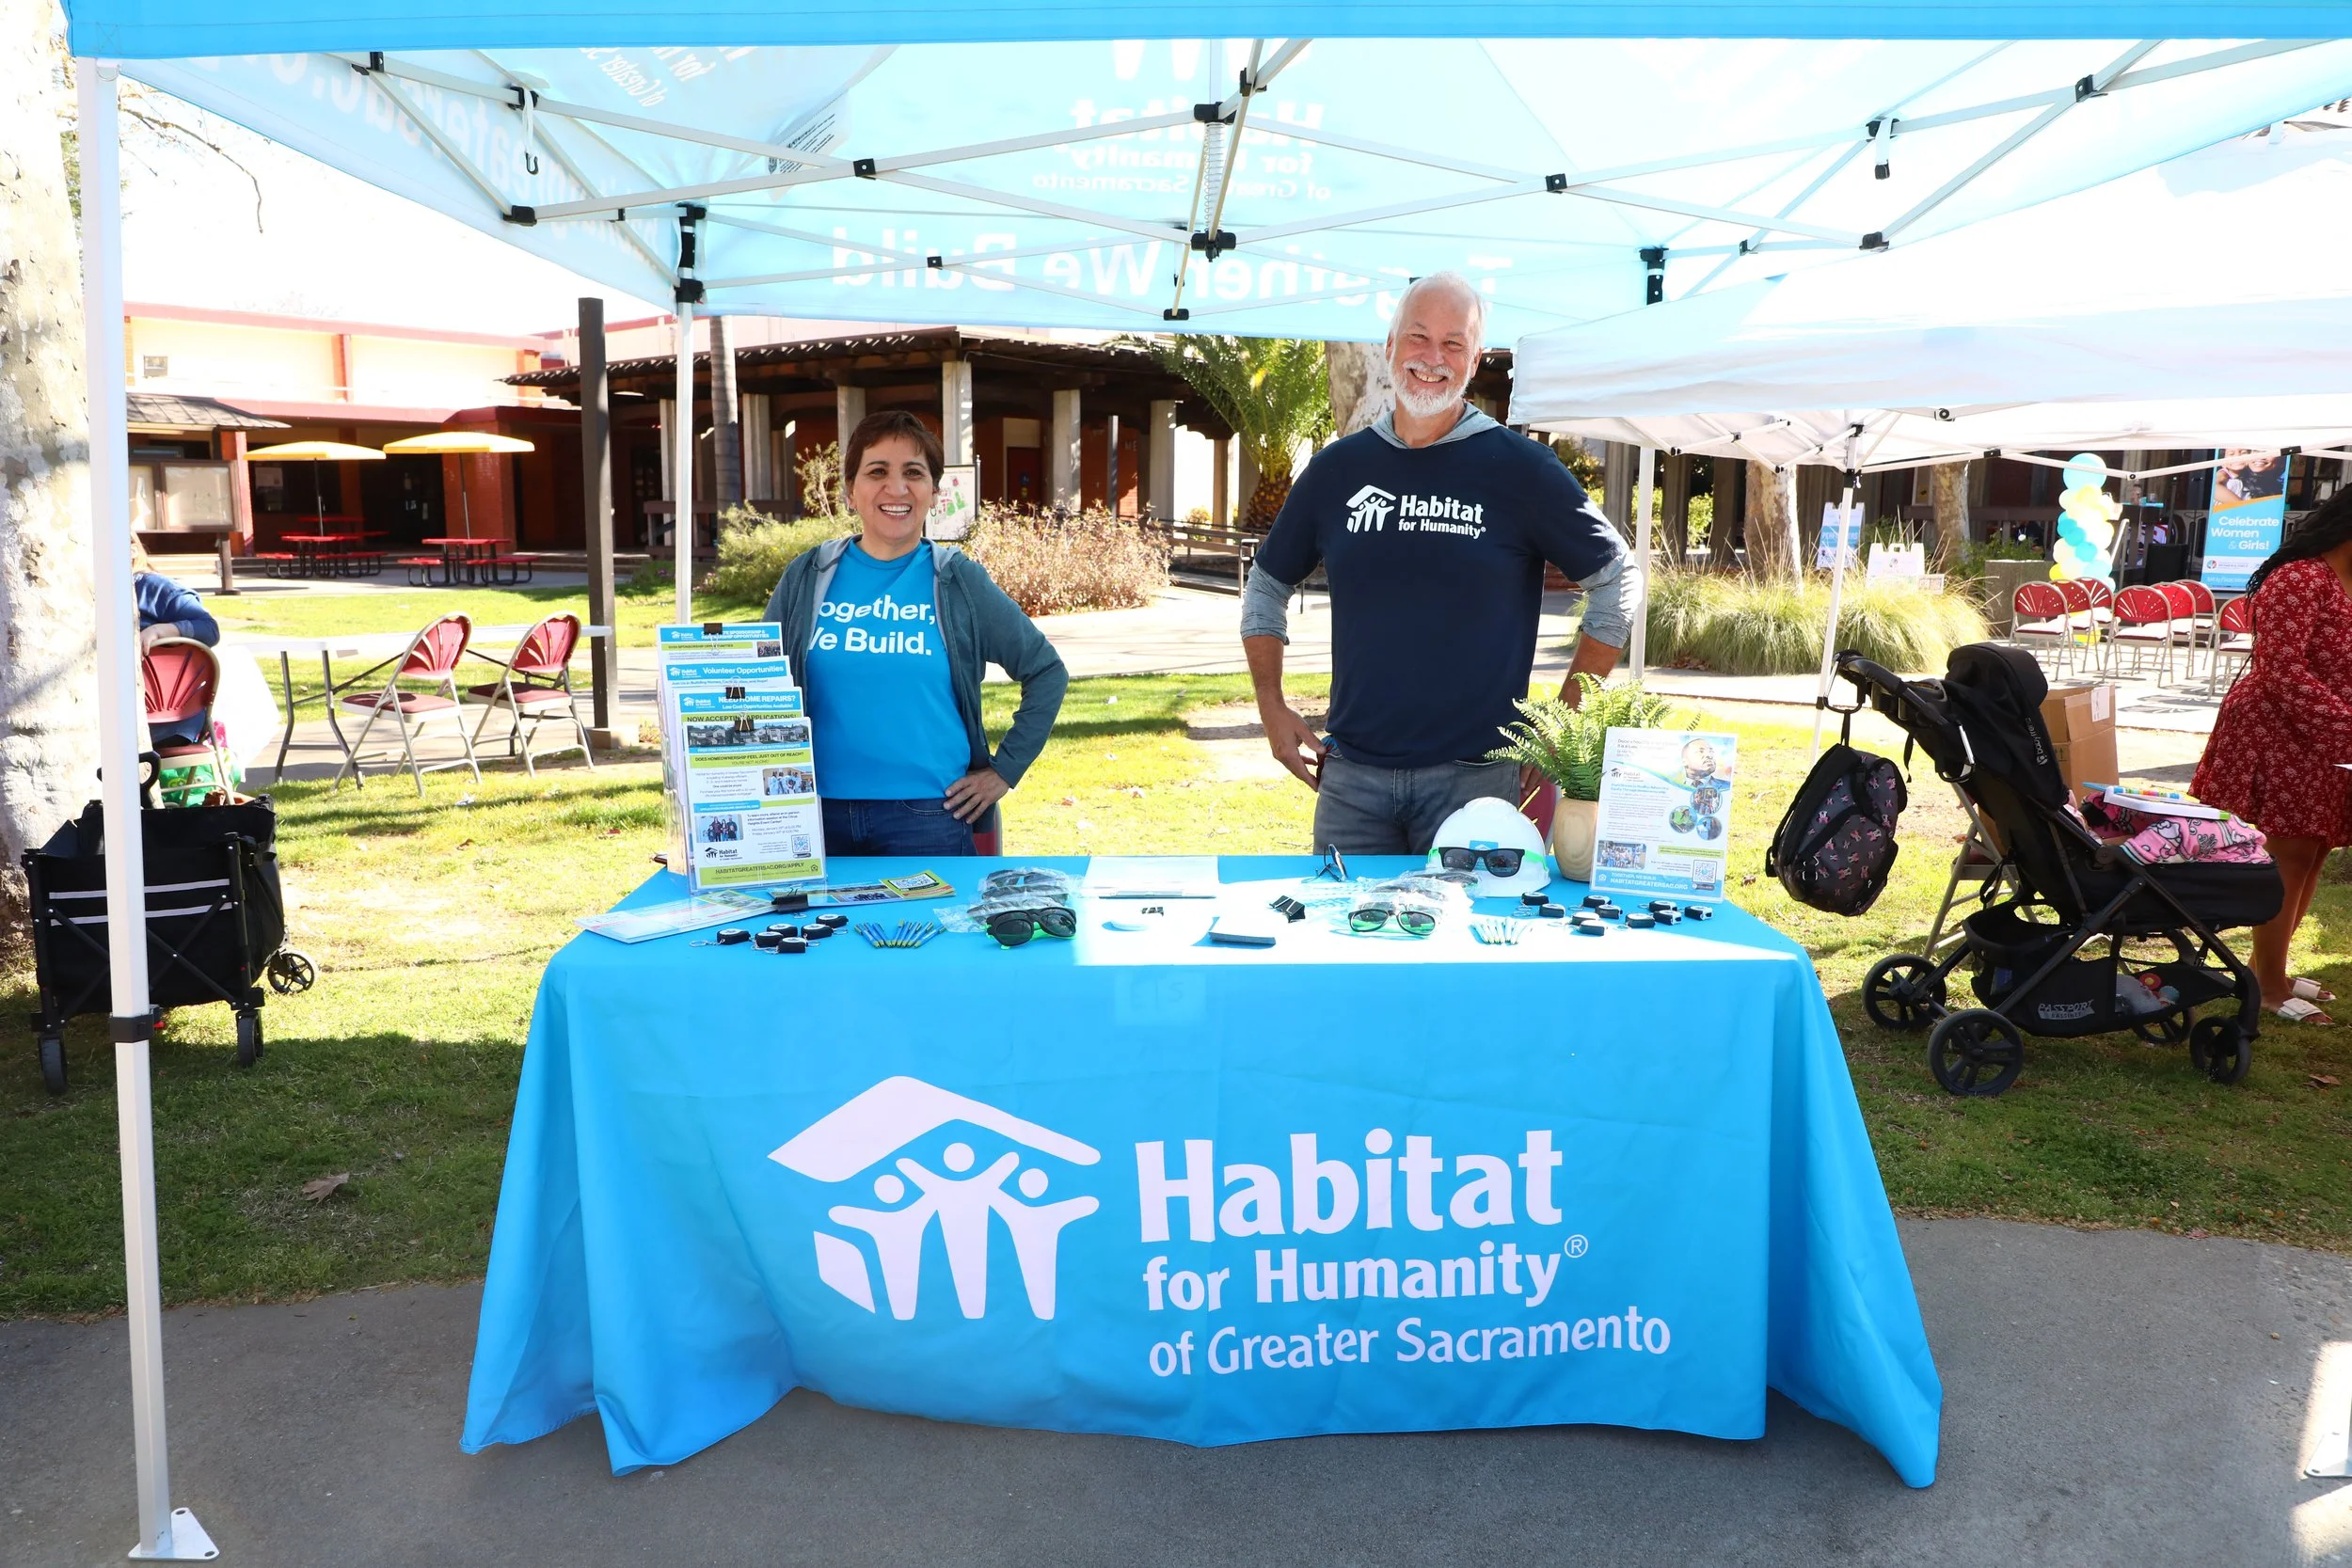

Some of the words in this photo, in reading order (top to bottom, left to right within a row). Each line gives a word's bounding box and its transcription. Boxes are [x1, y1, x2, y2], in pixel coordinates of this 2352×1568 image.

[1399, 495, 1483, 524] Habitat
[1398, 519, 1416, 531] for
[2218, 516, 2280, 526] Celebrate
[2211, 528, 2259, 538] Women
[2239, 540, 2270, 550] Girls!
[819, 594, 936, 625] ogether,
[844, 627, 932, 656] Build.
[737, 665, 784, 675] Opportunities
[2038, 999, 2095, 1014] PASSPORT
[1135, 1128, 1563, 1243] Habitat
[1143, 1256, 1230, 1312] for
[1149, 1331, 1193, 1377] of
[1208, 1323, 1380, 1376] Greater
[1397, 1306, 1671, 1364] Sacramento
